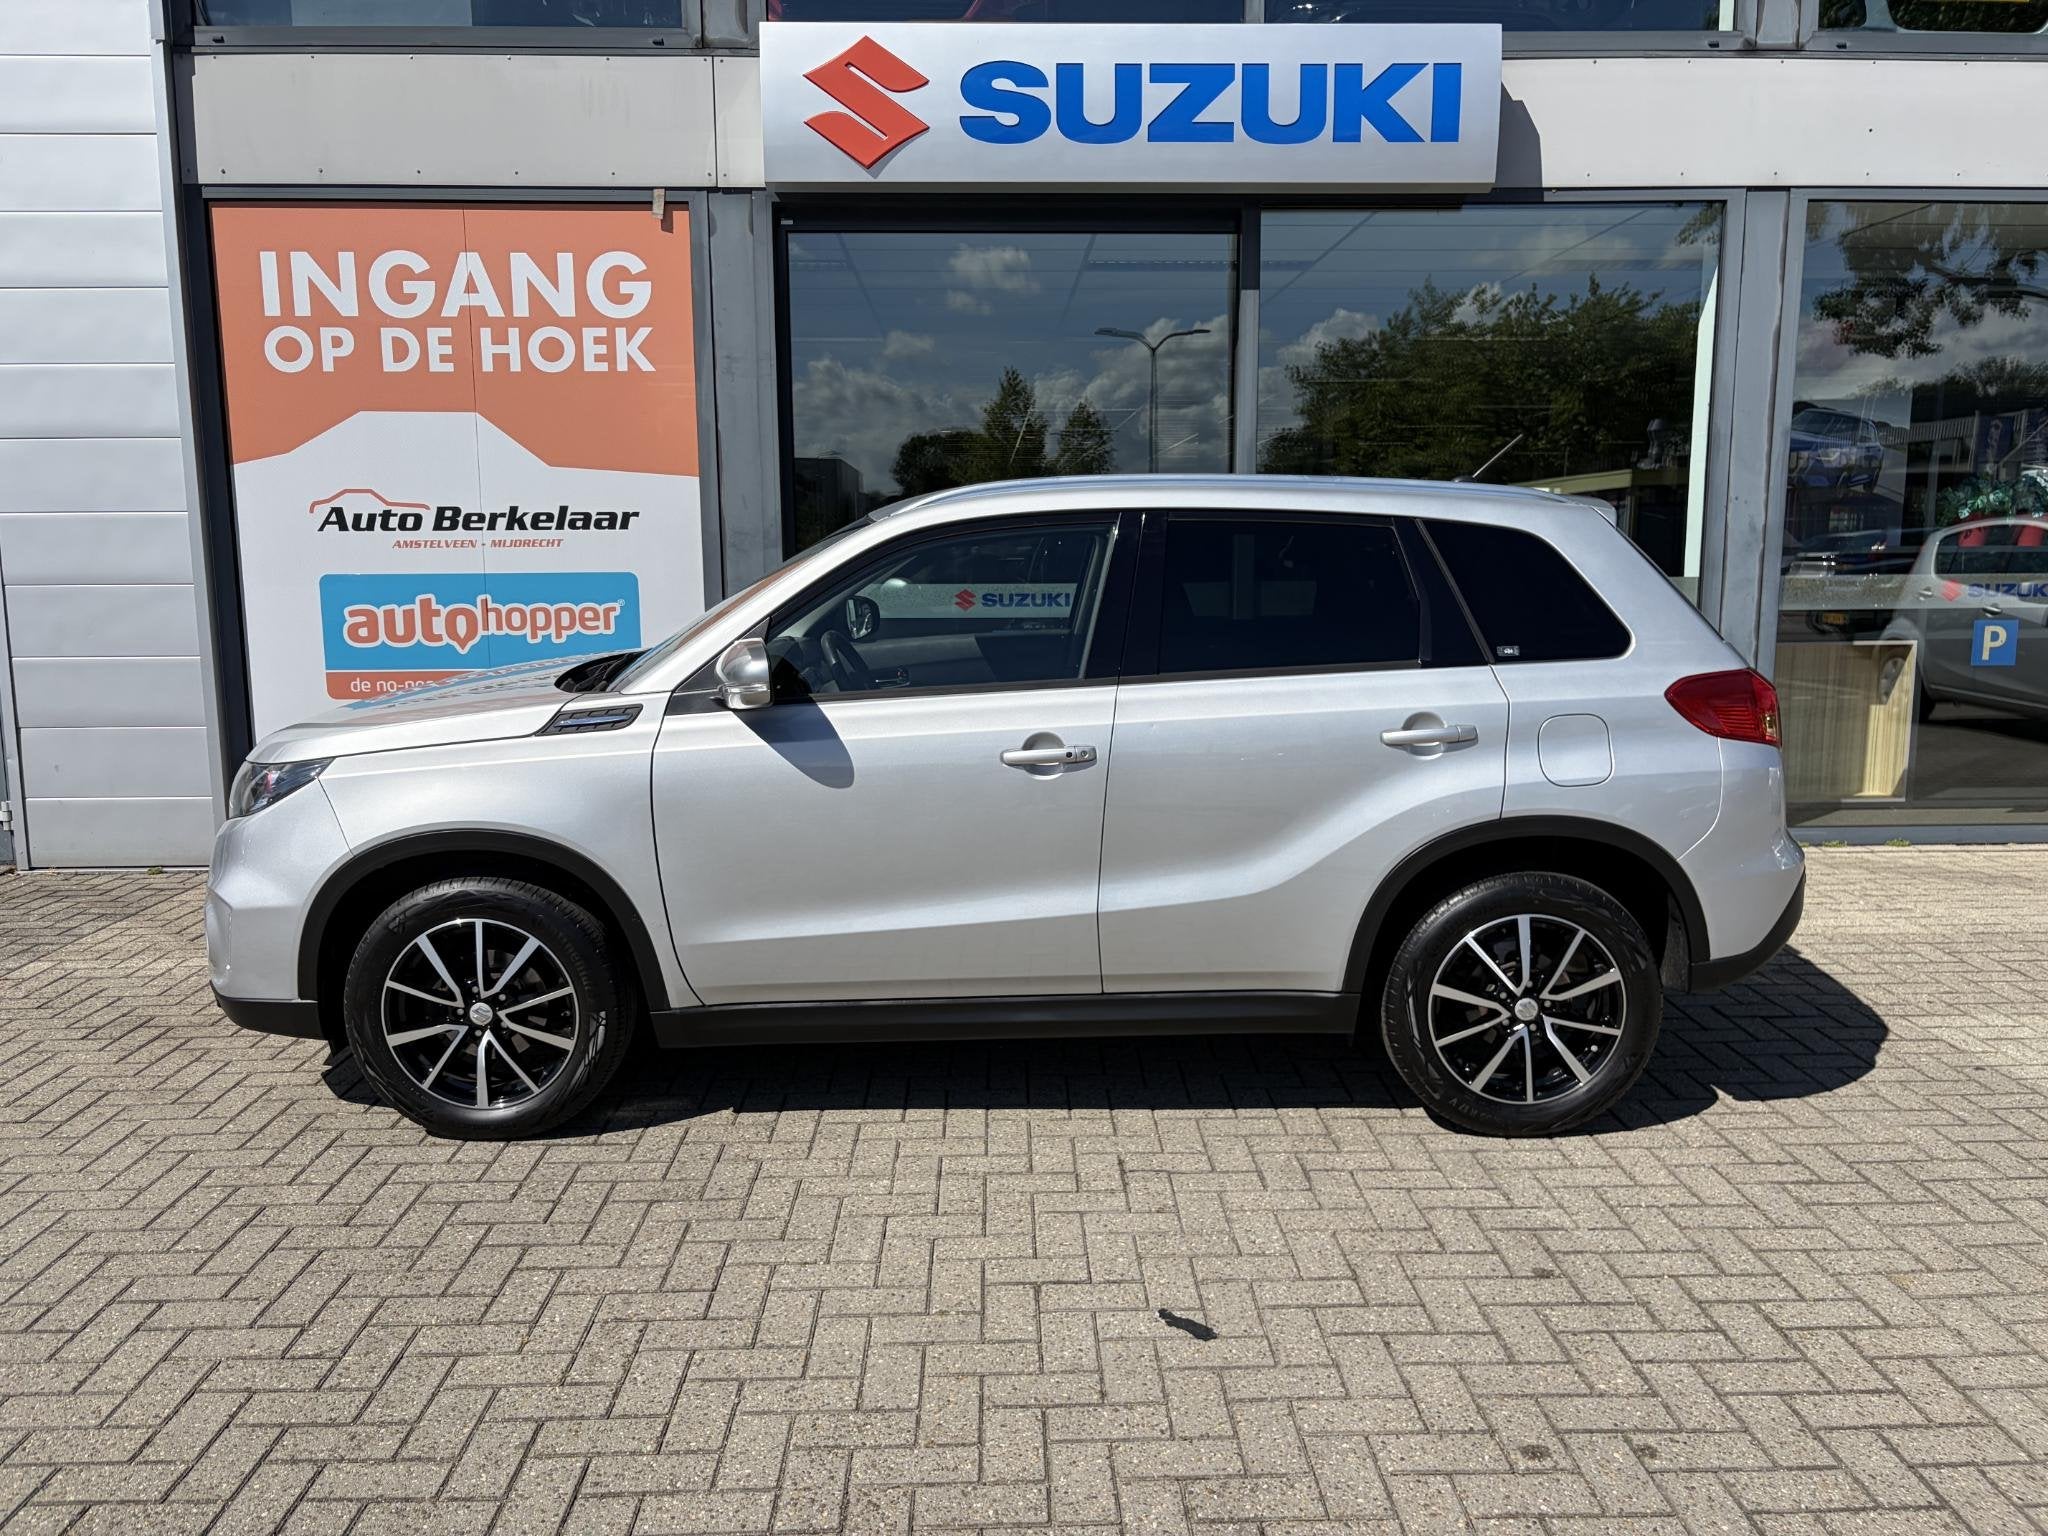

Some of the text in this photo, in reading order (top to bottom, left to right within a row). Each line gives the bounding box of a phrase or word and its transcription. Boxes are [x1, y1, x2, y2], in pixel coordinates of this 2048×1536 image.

[958, 60, 1462, 145] SUZUKI
[259, 249, 652, 319] INGANG
[264, 325, 656, 373] OP DE HOEK
[317, 505, 640, 532] Auto Berkelaar
[392, 538, 477, 549] AMSTELVEEN
[490, 538, 564, 548] MIJDRECHT
[981, 593, 1071, 608] SUZUKI
[1982, 625, 2007, 661] P
[350, 677, 371, 692] de
